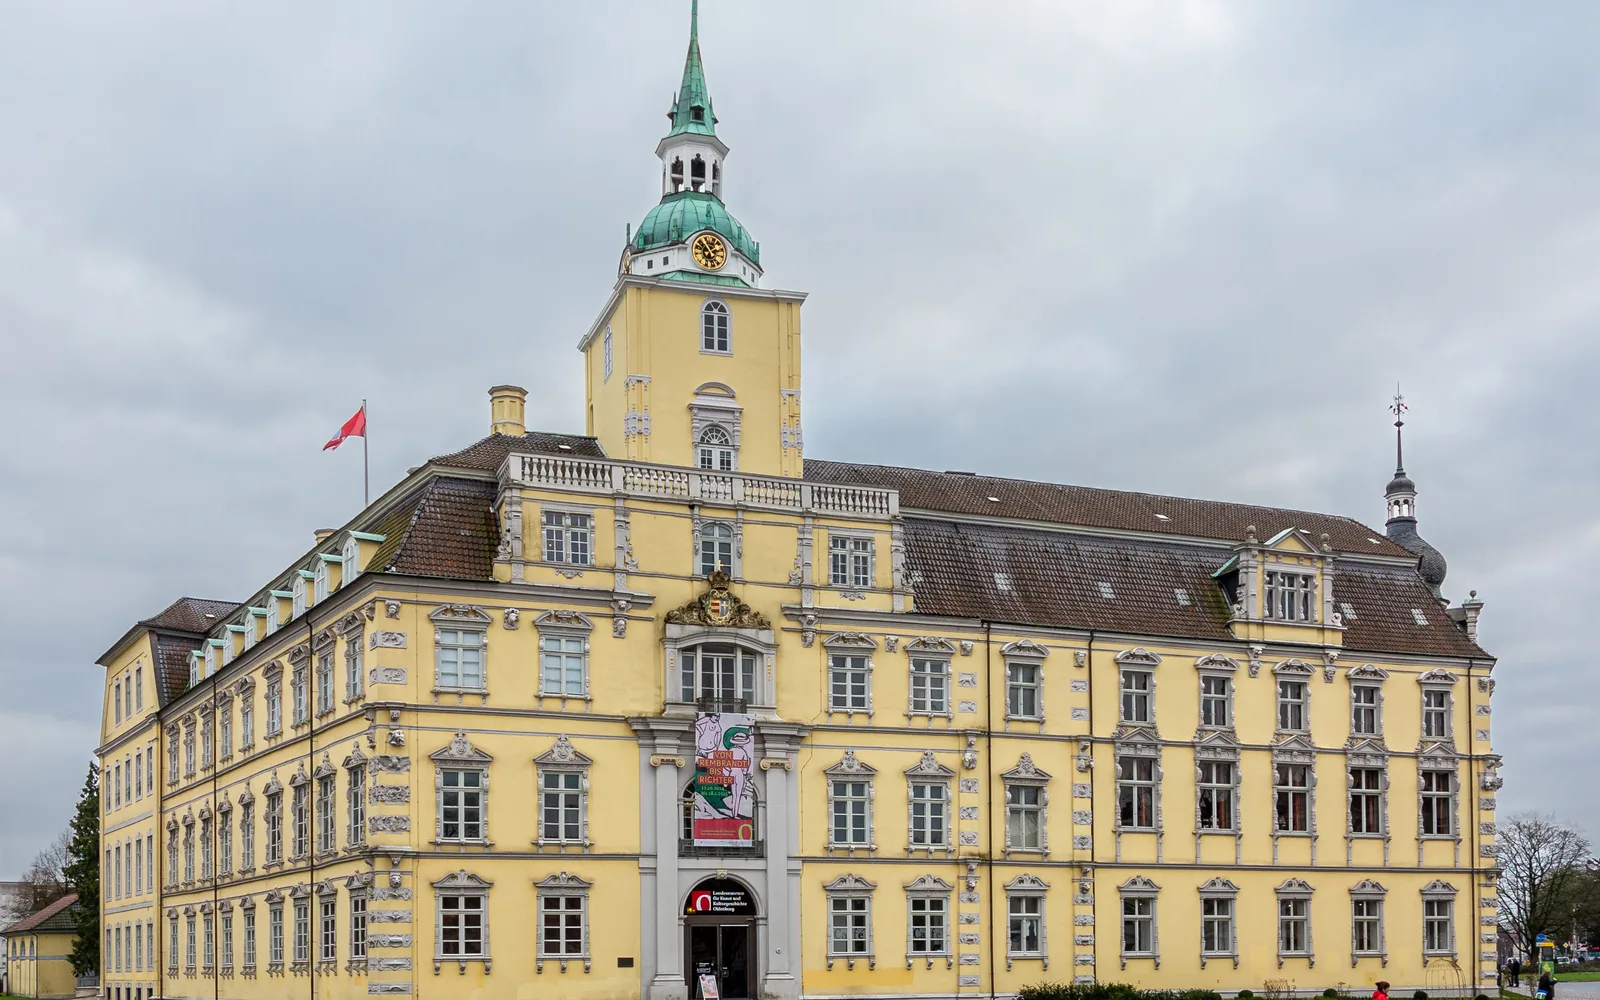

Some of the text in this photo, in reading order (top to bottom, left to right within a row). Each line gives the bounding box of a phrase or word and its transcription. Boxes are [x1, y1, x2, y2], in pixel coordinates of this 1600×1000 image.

[699, 759, 747, 767] REMBRANDT
[710, 767, 721, 775] BIS
[699, 775, 733, 784] RICHTER
[913, 928, 943, 939] Café
